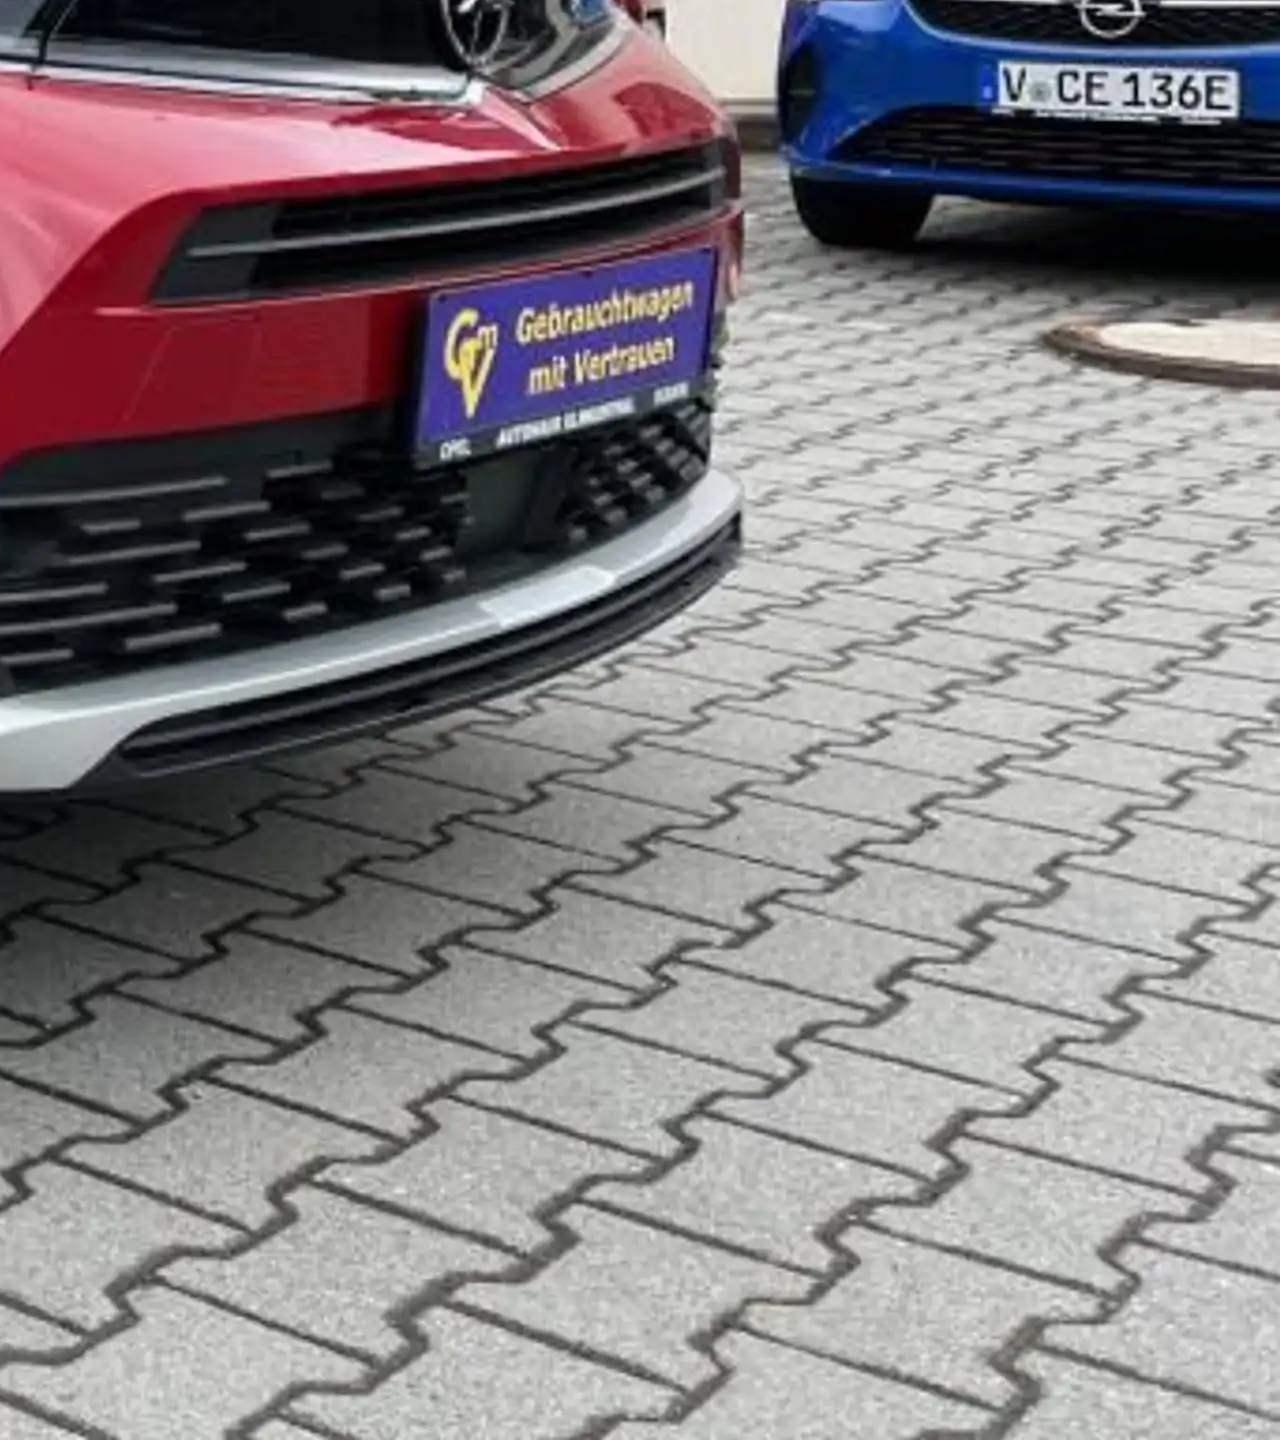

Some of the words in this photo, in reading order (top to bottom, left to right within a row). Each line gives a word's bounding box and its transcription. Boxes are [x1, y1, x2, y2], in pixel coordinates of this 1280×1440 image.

[1002, 67, 1027, 102] V
[1057, 70, 1111, 107] CE
[1122, 71, 1233, 111] 136E
[515, 279, 694, 345] Gebrauchtwagen
[526, 358, 566, 396] mit
[573, 335, 675, 386] Vertrauen
